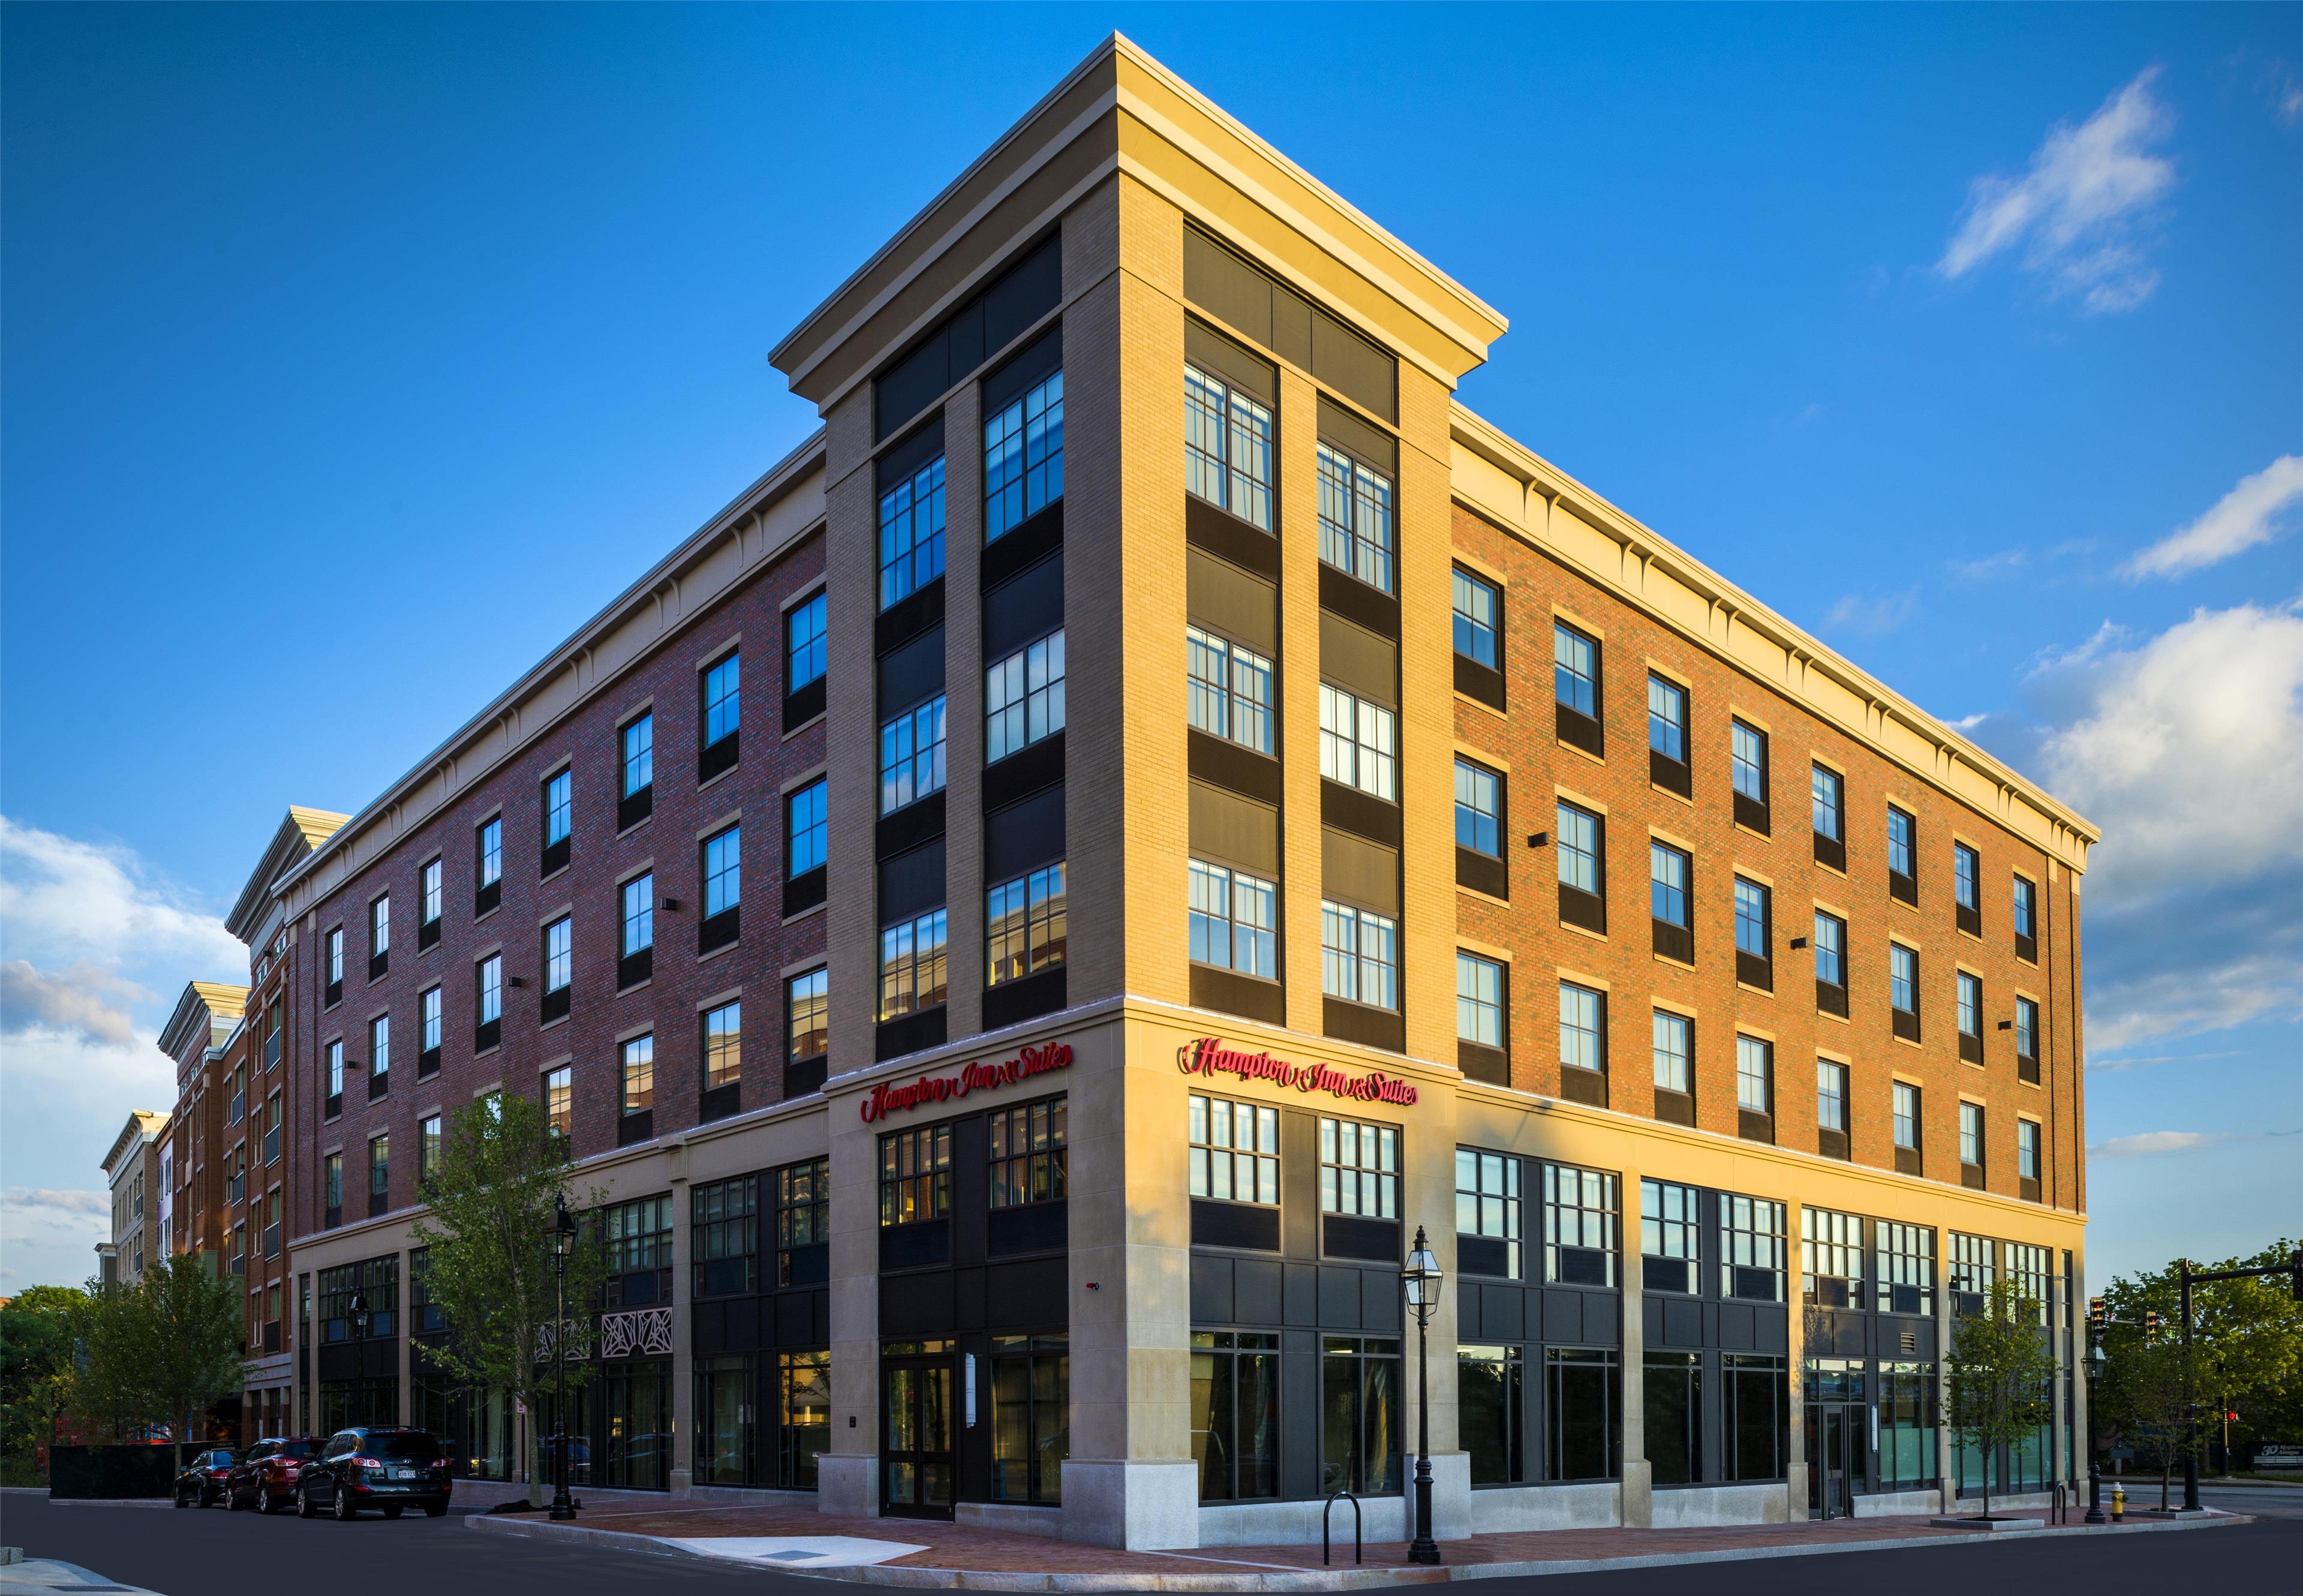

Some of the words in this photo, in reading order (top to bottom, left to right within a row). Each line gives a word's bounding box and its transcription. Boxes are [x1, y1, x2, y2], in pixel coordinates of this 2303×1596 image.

[861, 1077, 952, 1123] Hampton
[952, 1062, 1004, 1098] Inn
[1012, 1042, 1073, 1080] Suites
[1182, 1037, 1300, 1086] Hampton
[1300, 1063, 1355, 1096] Inn
[1354, 1078, 1370, 1100] &
[1365, 1072, 1418, 1105] Suites
[2261, 1445, 2278, 1456] 30
